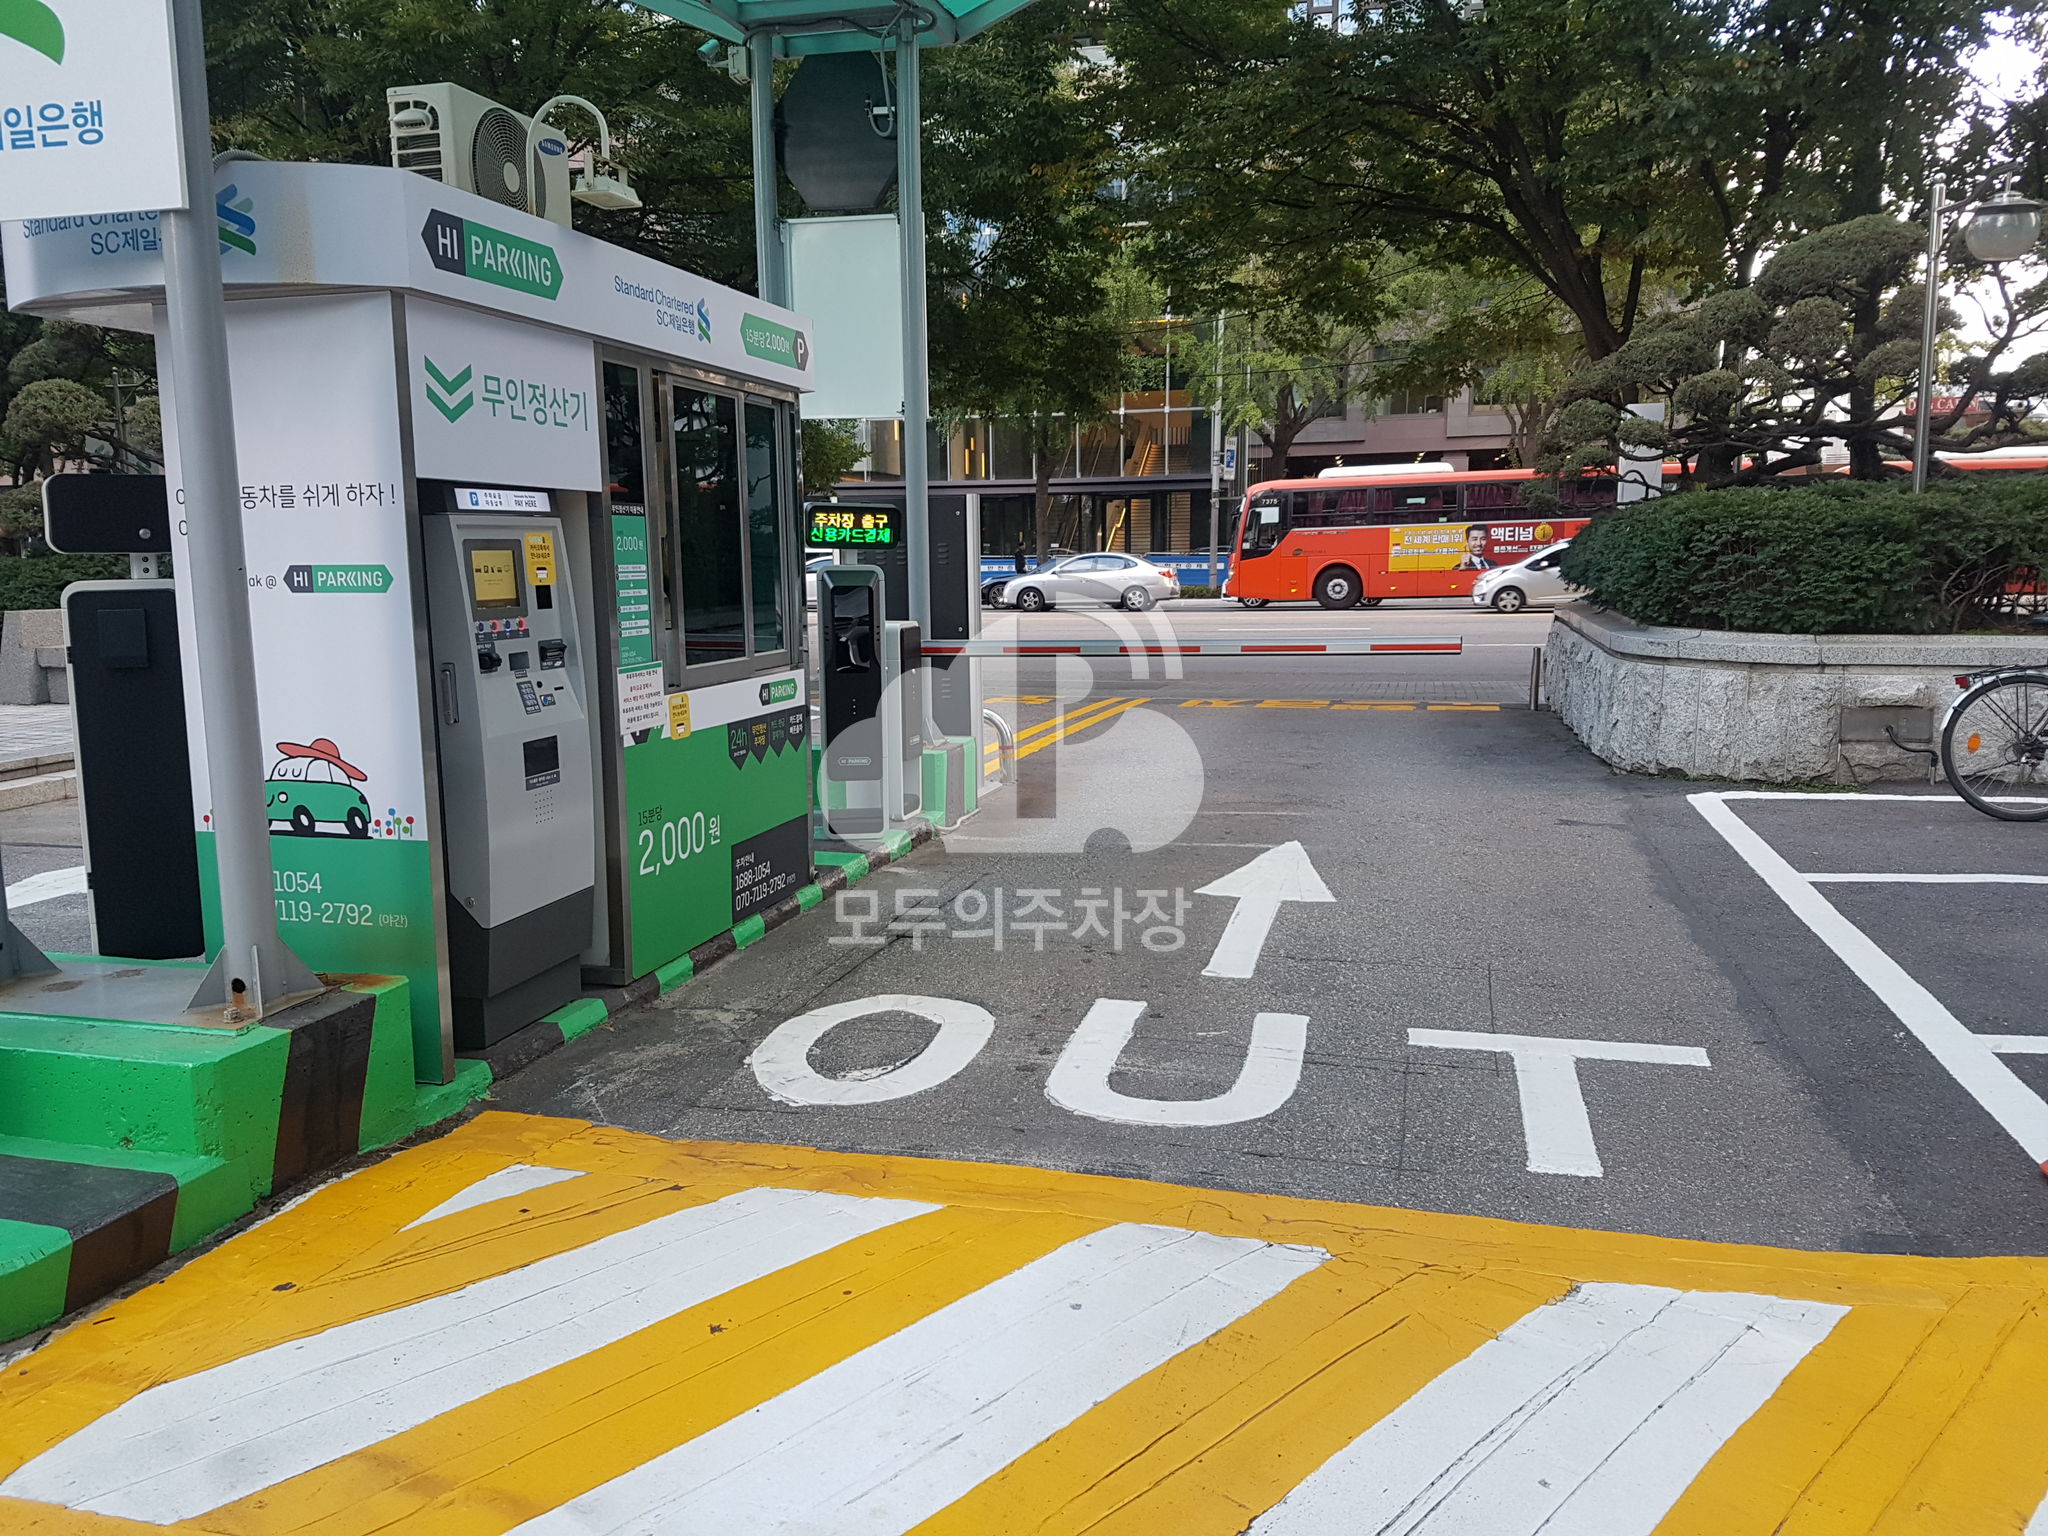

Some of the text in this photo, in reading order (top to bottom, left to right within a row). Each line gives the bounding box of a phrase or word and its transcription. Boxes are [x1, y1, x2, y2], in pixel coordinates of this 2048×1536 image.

[0, 99, 104, 150] 일은행
[541, 140, 563, 153] SAMSUNG
[91, 226, 162, 255] SC제일
[437, 224, 552, 287] HI PARKING
[614, 275, 694, 316] Standard Chartered
[656, 309, 695, 336] SC제일은행
[482, 374, 588, 431] 무인정산기
[240, 484, 296, 510] 동차를
[303, 483, 340, 508] 쉬게
[346, 482, 384, 507] 하자
[514, 499, 537, 508] PAY HERE
[814, 512, 889, 529] 주차장 출구
[617, 536, 638, 552] 2,000
[810, 527, 891, 543] 신용카드결제
[1490, 526, 1533, 542] 액티넘
[248, 574, 263, 587] ak
[293, 571, 383, 587] HI PARKING
[762, 683, 795, 701] HI PARKING
[730, 727, 748, 750] 24h
[638, 804, 663, 826] 15분당
[638, 811, 721, 876] 2,000 원
[273, 870, 322, 894] 1054
[735, 860, 771, 891] 1688-1054
[735, 872, 786, 911] 070-7119-2792
[275, 899, 408, 928] 119-2792 (야간)
[748, 994, 1712, 1177] OUT
